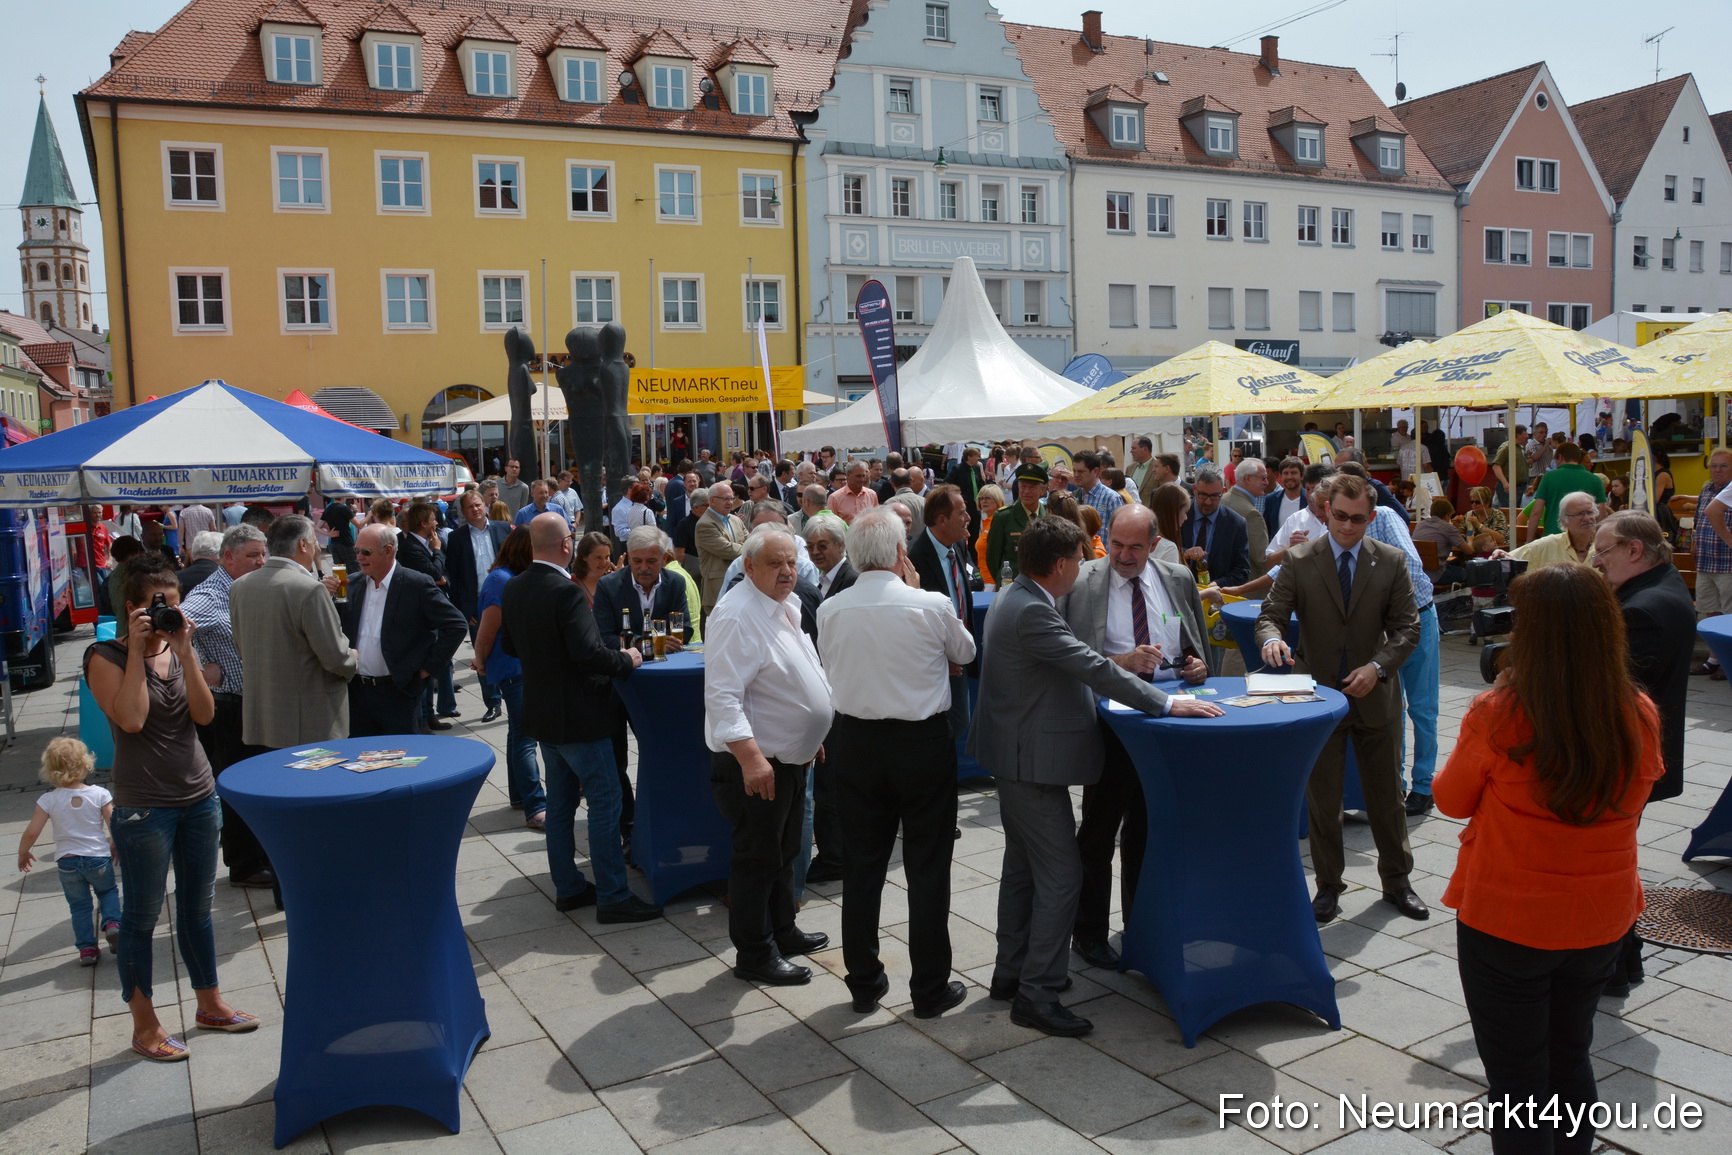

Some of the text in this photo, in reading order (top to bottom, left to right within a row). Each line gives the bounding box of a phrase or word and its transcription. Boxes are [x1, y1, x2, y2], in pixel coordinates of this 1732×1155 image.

[898, 239, 1001, 257] BRILLEN WEBER
[1382, 348, 1517, 387] Glossner
[1563, 347, 1624, 375] Glossner
[1435, 368, 1493, 382] Bier
[637, 377, 758, 392] NEUMARKTneu
[1237, 371, 1300, 396] Glossner
[1284, 384, 1319, 394] Bier
[638, 395, 759, 405] Vortrag, Diskussion, Gespräche
[17, 473, 70, 487] NEUMARKTER
[100, 470, 190, 484] NEUMARKTER
[211, 468, 298, 482] NEUMARKTER
[330, 466, 382, 478] NUMARKER
[116, 487, 177, 496] Nachrichten
[226, 484, 284, 494] Nachrichten
